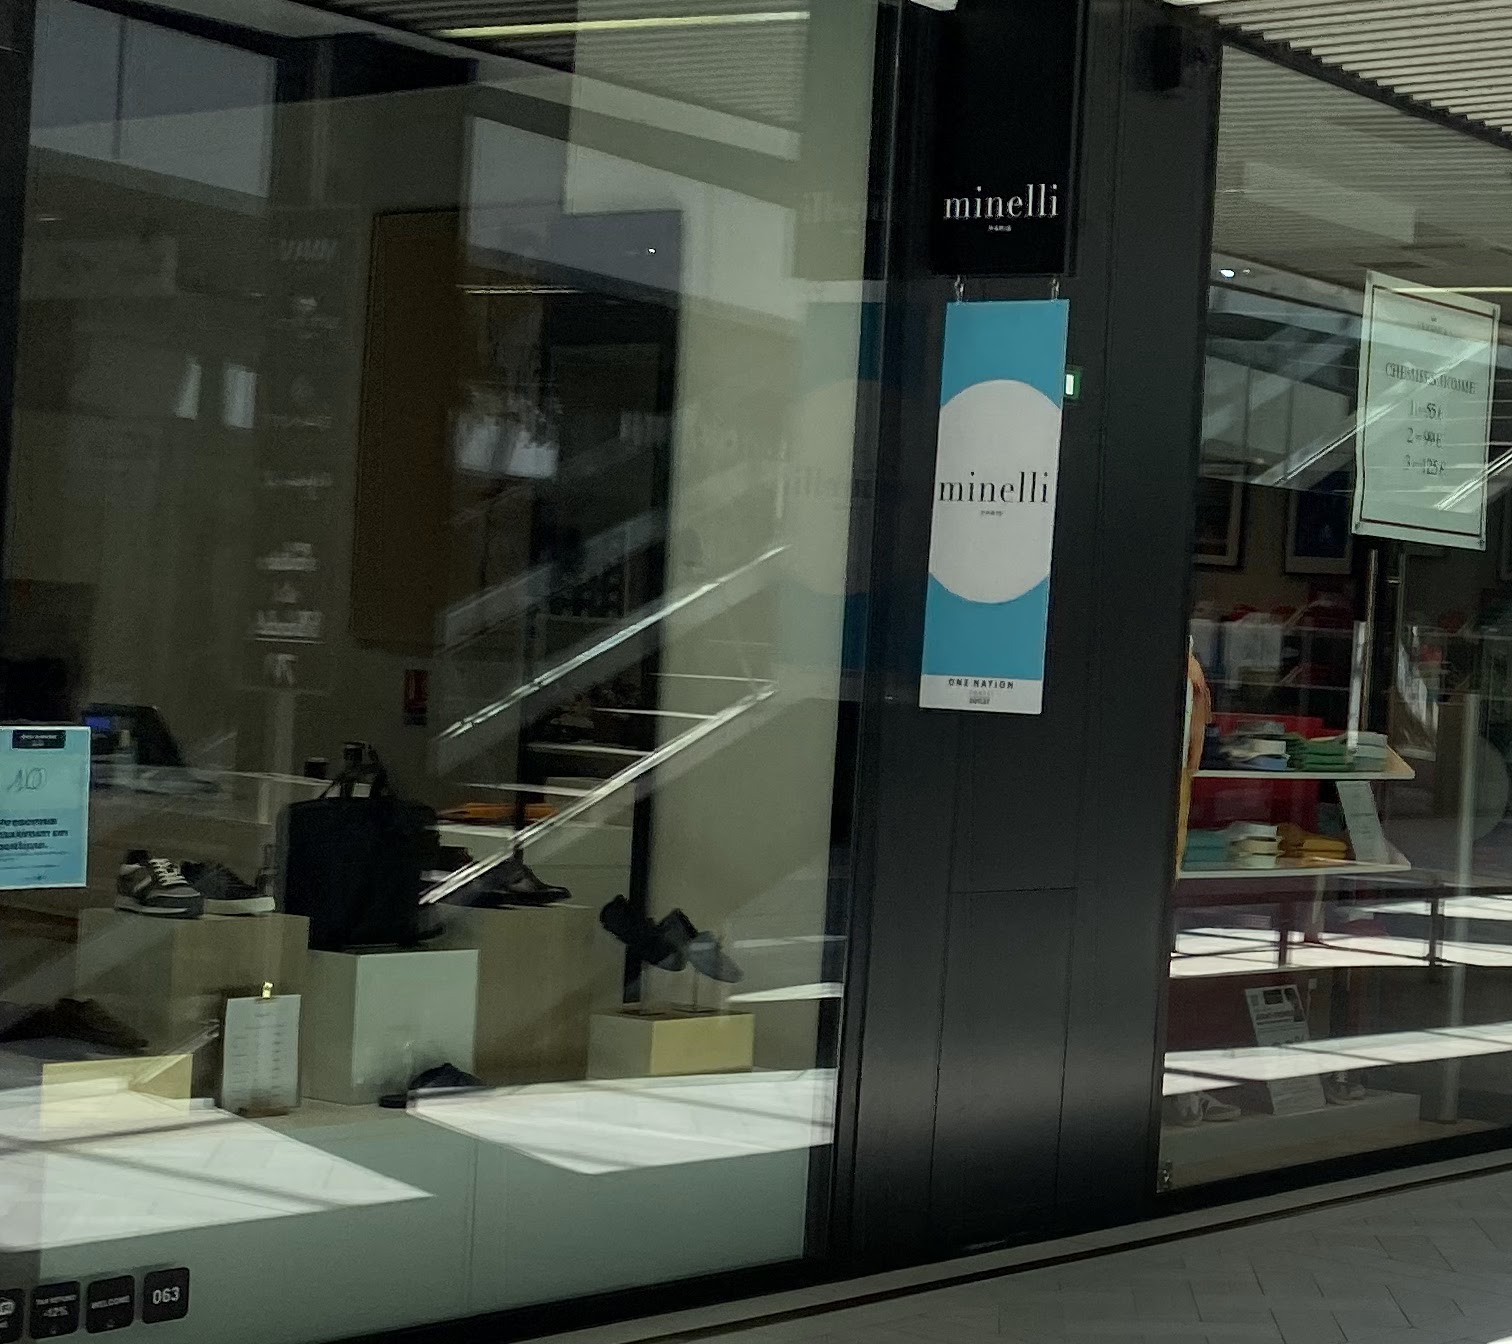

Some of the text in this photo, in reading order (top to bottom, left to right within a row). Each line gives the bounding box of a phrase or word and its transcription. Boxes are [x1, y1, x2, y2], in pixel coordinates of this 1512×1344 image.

[943, 184, 1059, 220] minelli
[938, 471, 1050, 504] minelli
[973, 679, 1014, 690] NATION
[152, 1286, 181, 1305] 063
